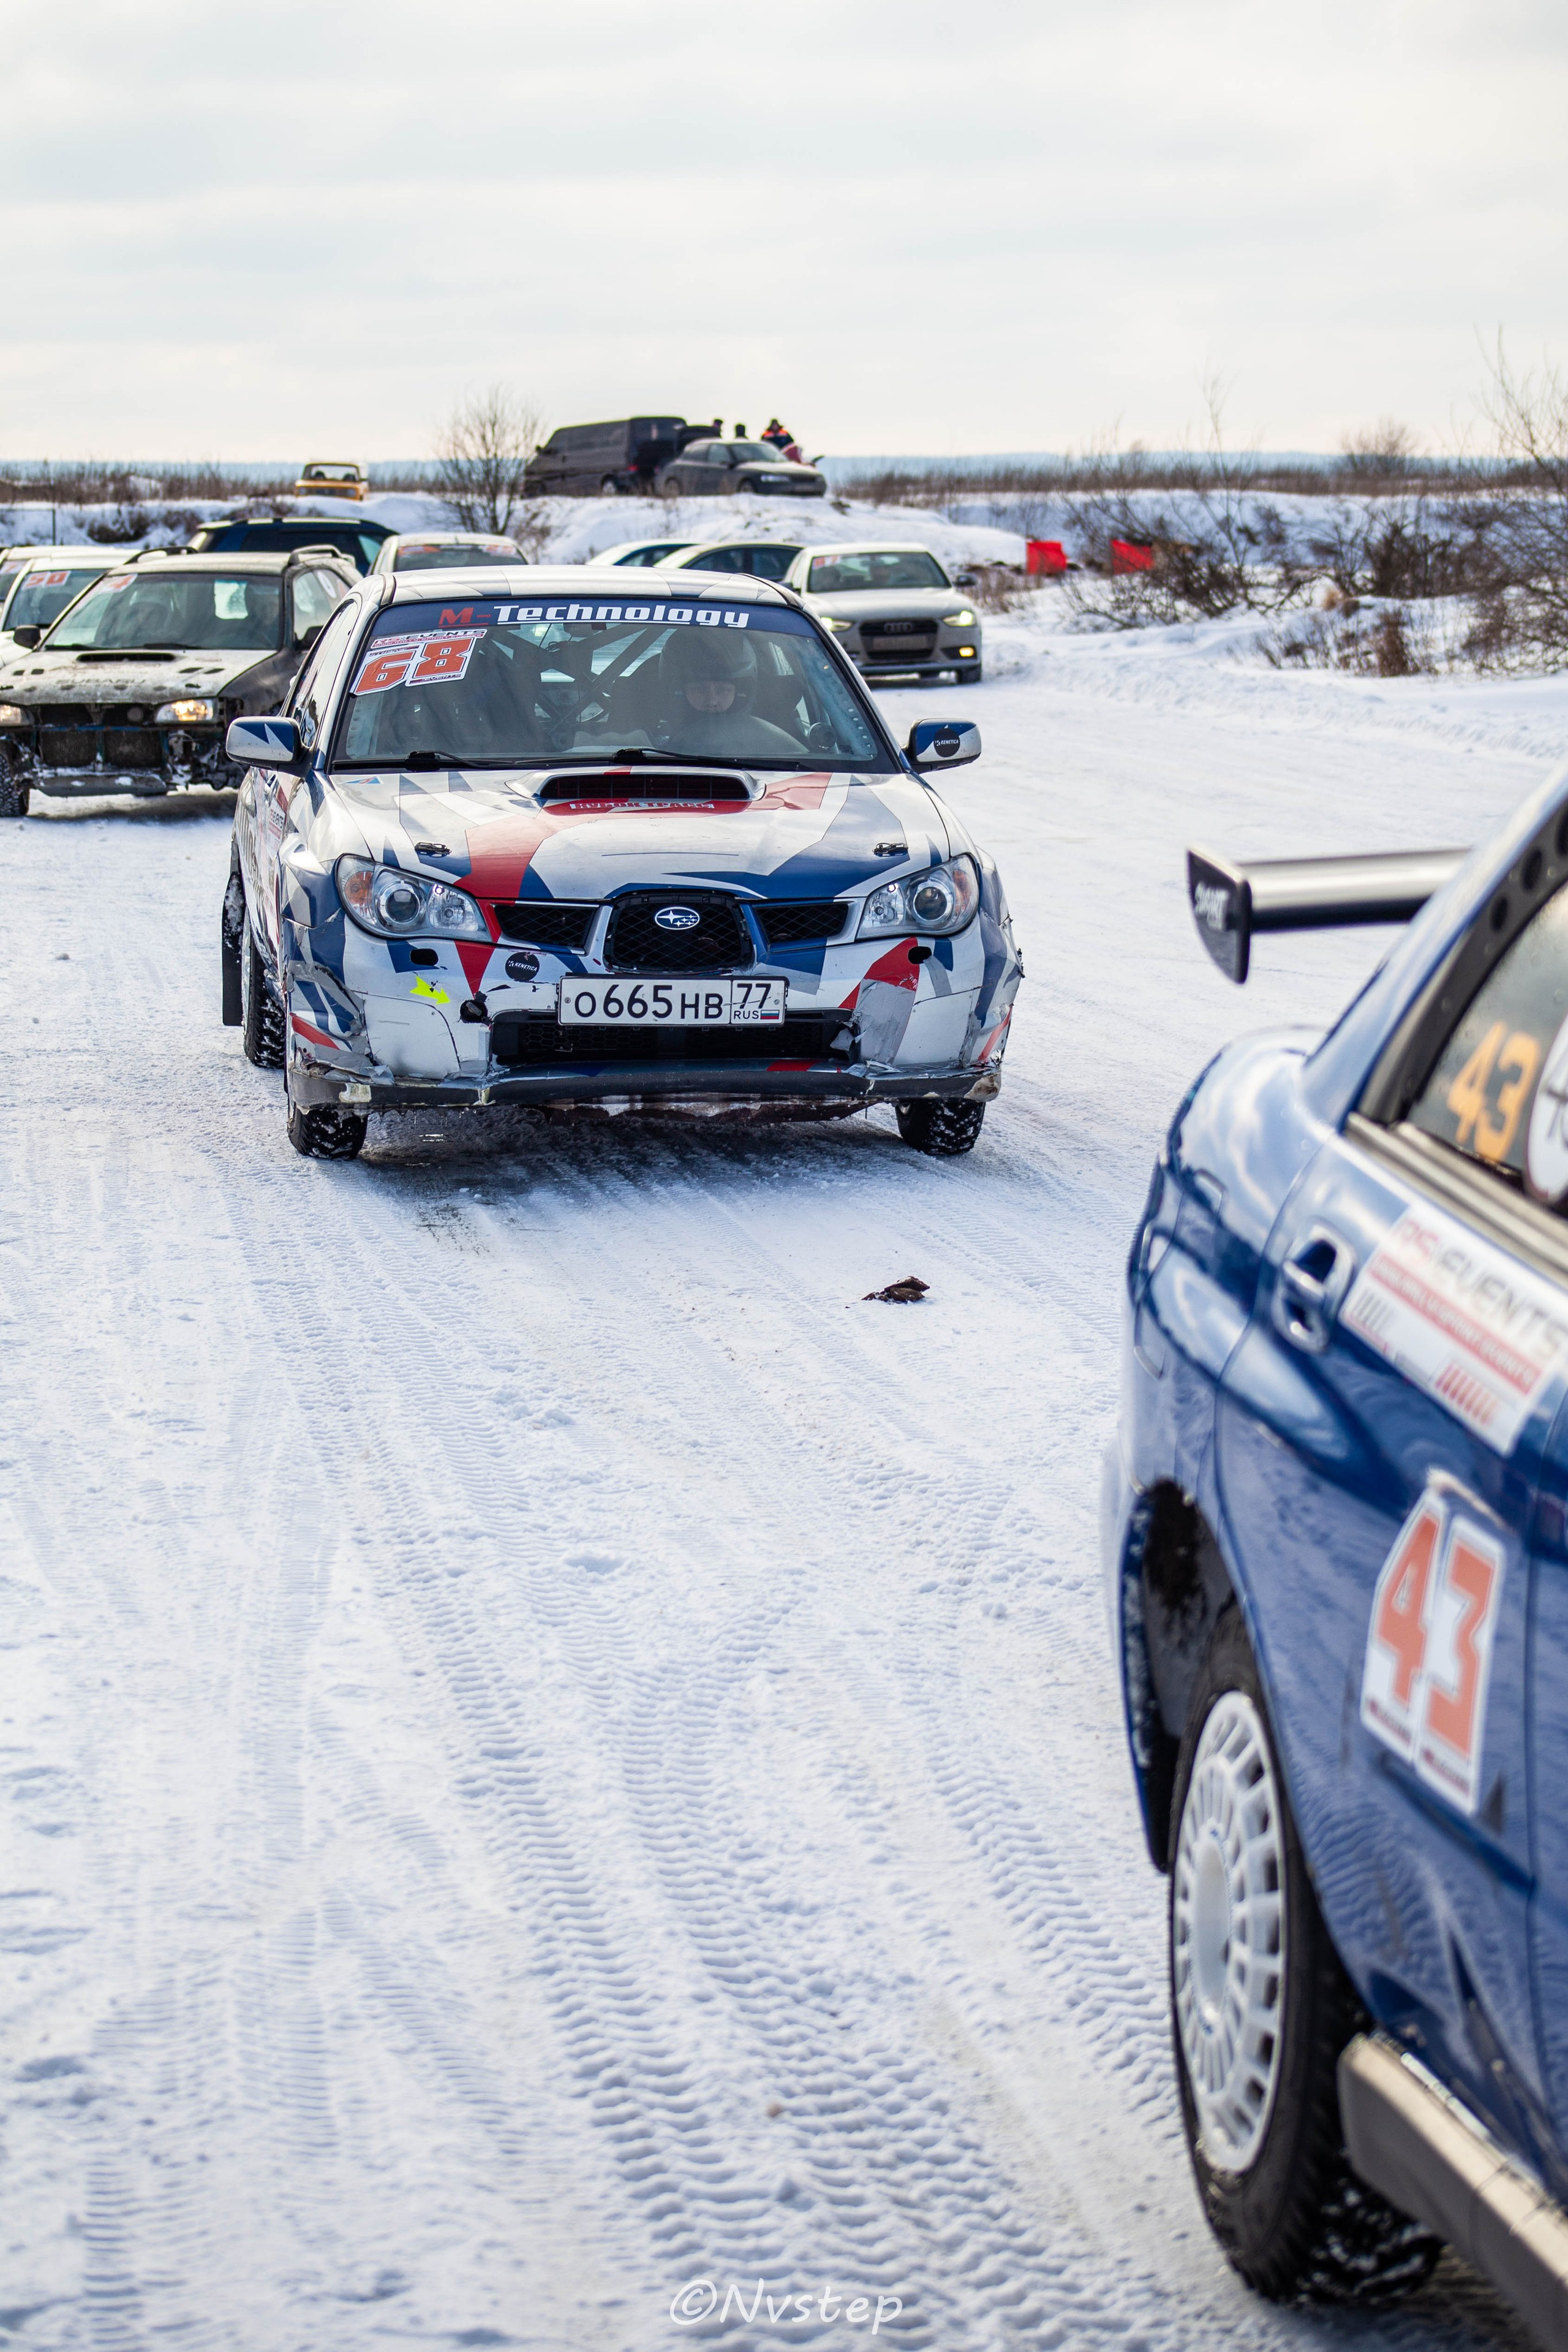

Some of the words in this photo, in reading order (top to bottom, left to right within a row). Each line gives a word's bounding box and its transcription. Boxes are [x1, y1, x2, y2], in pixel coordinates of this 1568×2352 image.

[355, 638, 473, 693] 68
[514, 962, 537, 971] KENETICA
[734, 1011, 760, 1019] RUS
[736, 984, 771, 1009] 77
[1446, 1020, 1542, 1161] 43
[1376, 1511, 1494, 1763] 43
